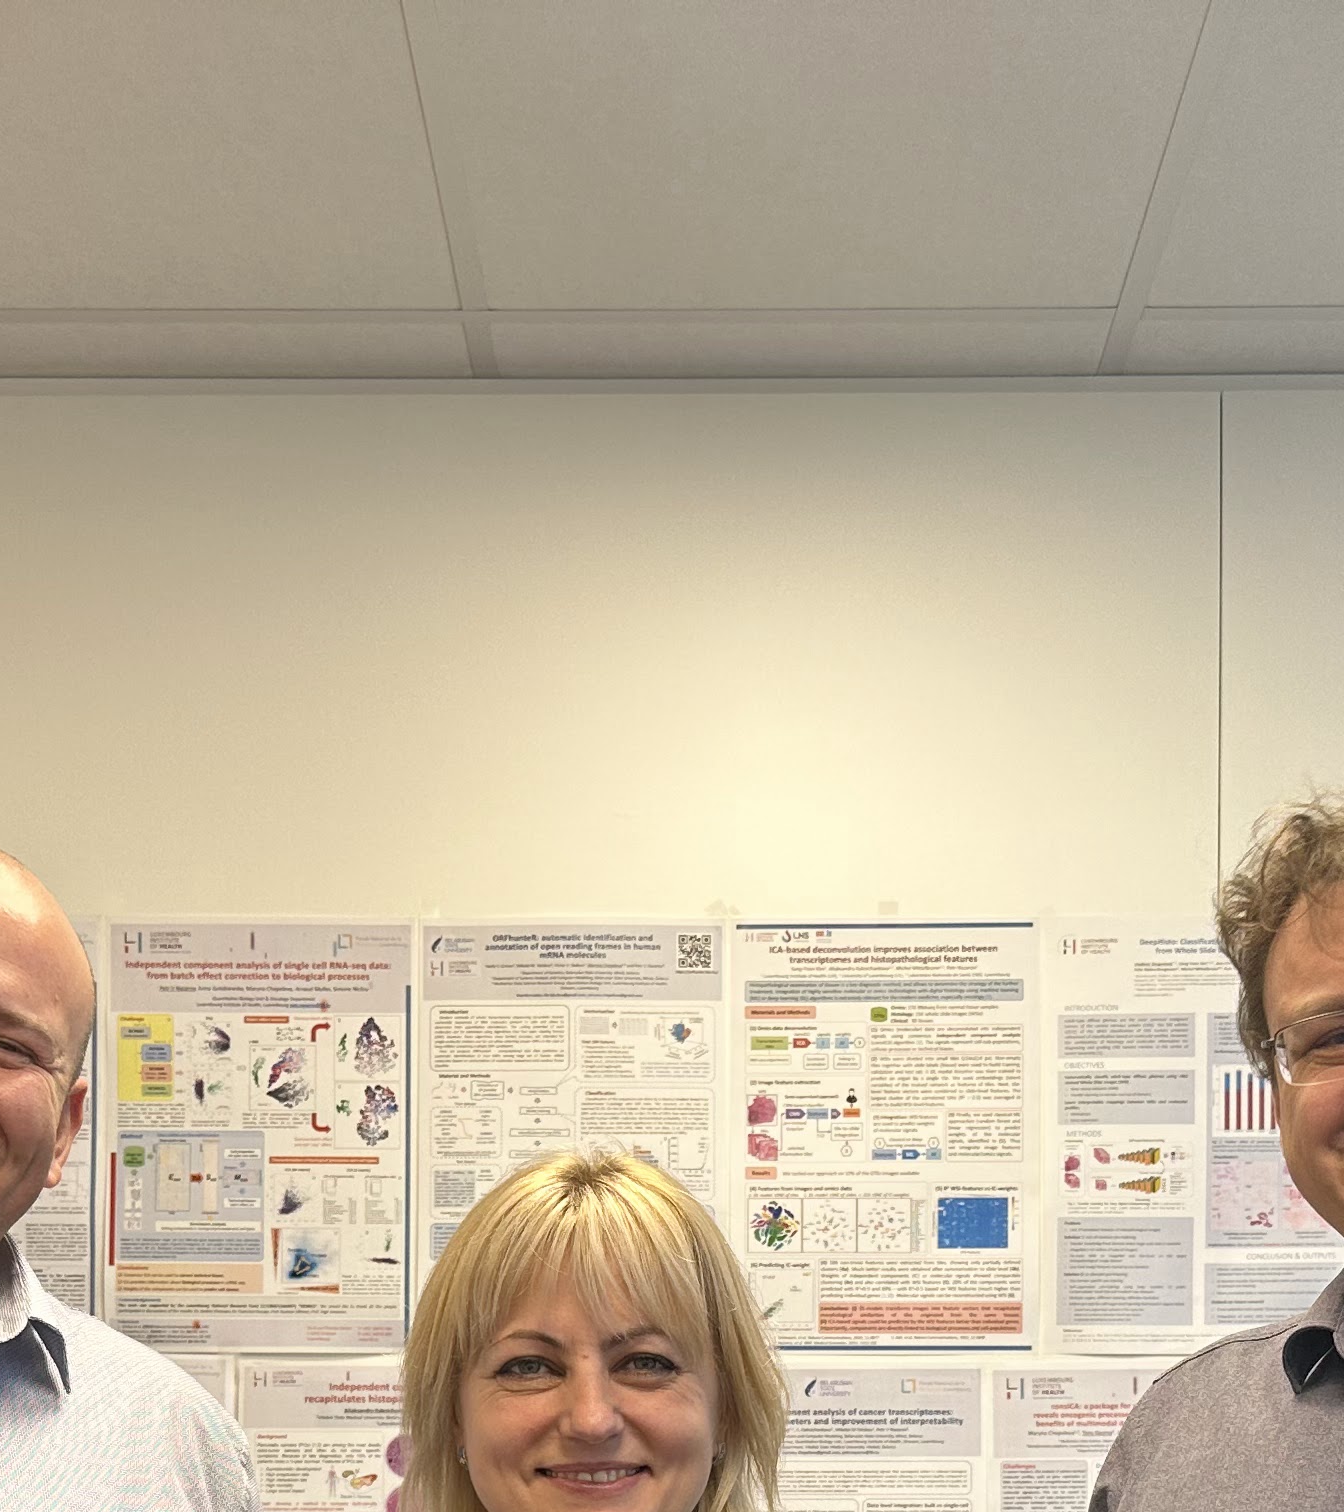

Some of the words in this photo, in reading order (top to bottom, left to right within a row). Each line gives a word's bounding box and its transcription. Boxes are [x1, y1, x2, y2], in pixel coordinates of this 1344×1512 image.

[485, 943, 528, 951] annotation
[530, 943, 539, 951] of
[540, 943, 560, 951] open
[562, 943, 592, 951] reading
[594, 943, 621, 951] frames
[623, 943, 631, 951] in
[633, 943, 661, 951] human
[873, 945, 911, 954] improves
[913, 945, 959, 953] association
[961, 945, 998, 953] between
[789, 956, 851, 964] transcriptomes
[870, 956, 941, 964] histopathological
[125, 961, 181, 970] Independent
[184, 961, 233, 970] component
[236, 961, 270, 970] analysis
[272, 961, 282, 970] of
[284, 961, 309, 970] single
[311, 961, 327, 970] cell
[329, 961, 367, 970] RNA-seq
[146, 972, 168, 980] from
[170, 972, 195, 980] batch
[197, 972, 222, 980] effect
[224, 972, 269, 980] correction
[283, 973, 325, 981] biological
[327, 973, 370, 981] processes
[1064, 1061, 1105, 1069] OBJECTIVES
[1246, 1252, 1293, 1260] CONCLUSION
[1302, 1252, 1337, 1260] OUTPUTS
[329, 1383, 389, 1392] Independent
[304, 1395, 366, 1404] recapitulates
[813, 1408, 845, 1417] analysis
[831, 1418, 887, 1426] improvement
[900, 1417, 963, 1426] interpretability
